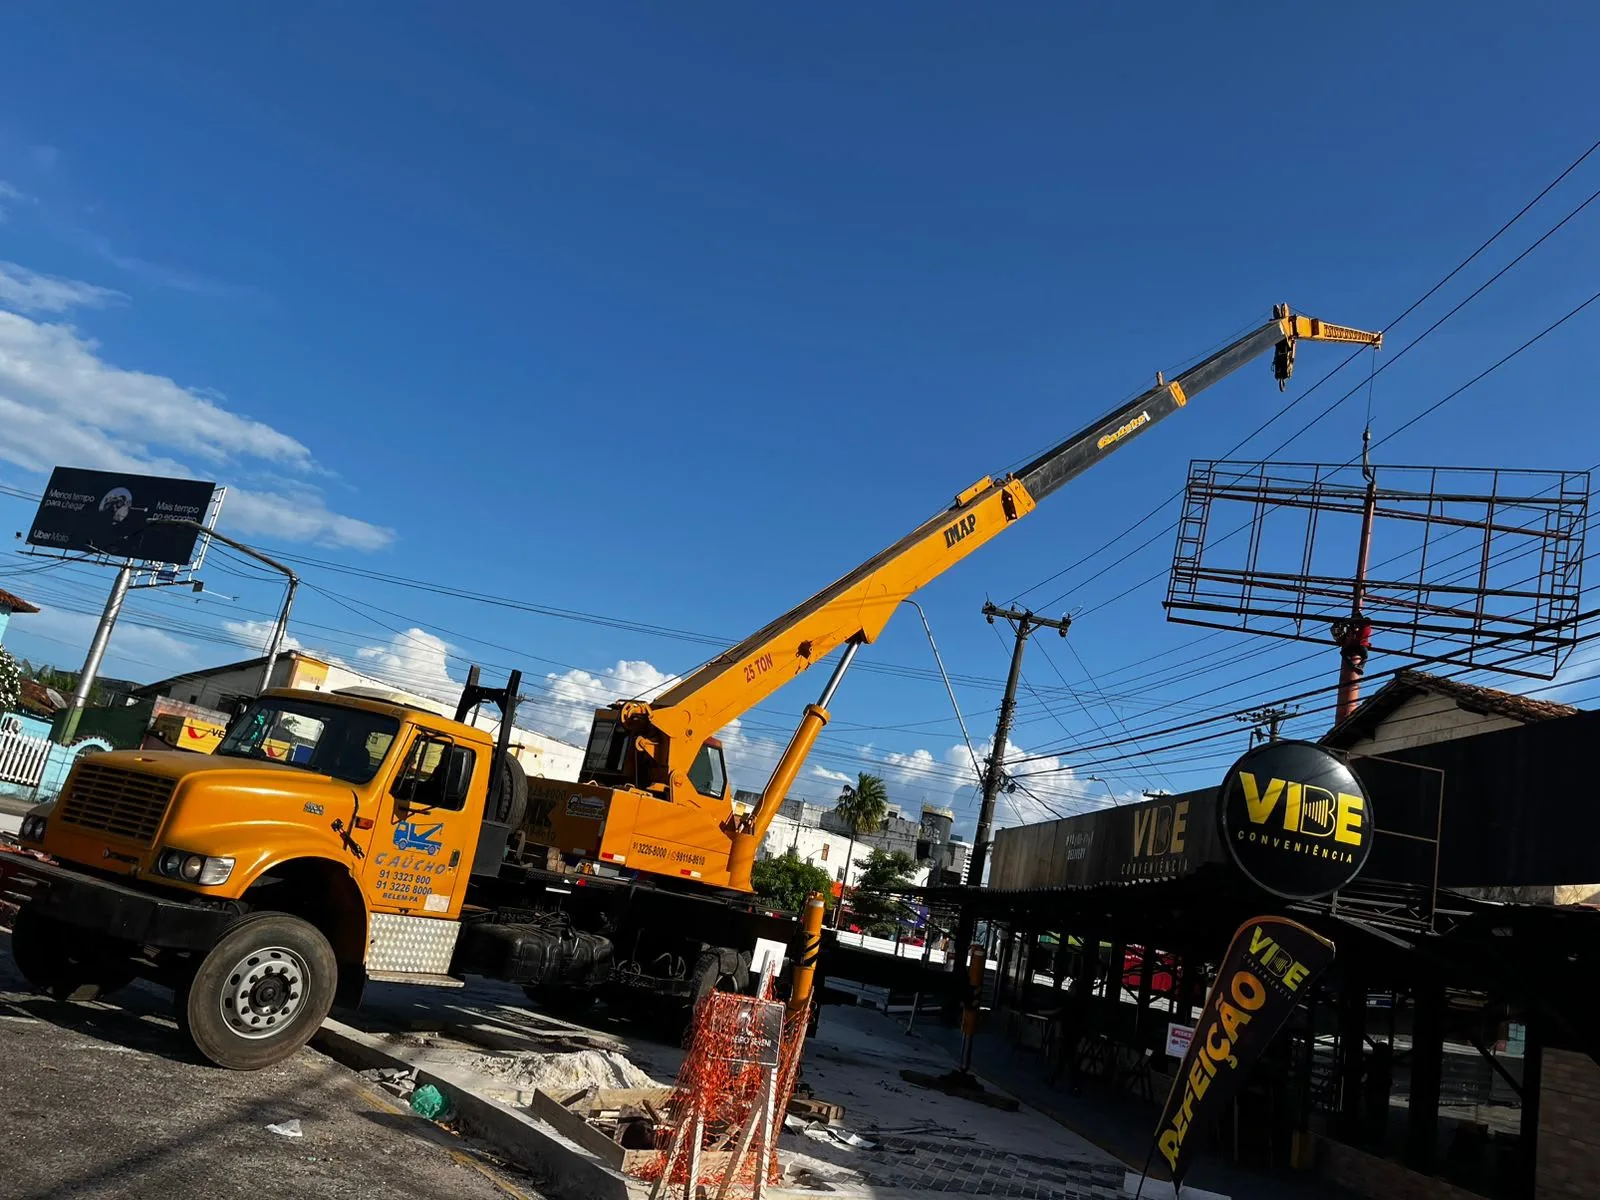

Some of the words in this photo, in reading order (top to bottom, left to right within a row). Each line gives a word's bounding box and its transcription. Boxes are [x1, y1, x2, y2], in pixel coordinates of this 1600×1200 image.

[49, 489, 72, 500] Menos
[73, 493, 95, 502] tempo
[174, 504, 200, 514] tempo
[33, 530, 51, 540] Uber
[50, 532, 70, 543] Moto
[943, 513, 976, 549] IMAP
[743, 664, 756, 684] 25
[754, 653, 774, 675] TON
[1238, 771, 1364, 846] VIBE
[1133, 800, 1190, 857] VIBE
[1237, 830, 1354, 865] CONVENIÊNCIA
[376, 880, 387, 889] 91
[390, 882, 410, 893] 3226
[413, 885, 433, 895] 8000
[379, 869, 390, 879] 91
[393, 871, 414, 882] 3323
[1249, 926, 1310, 992] VIBE
[1158, 971, 1266, 1172] REFEIÇÃO
